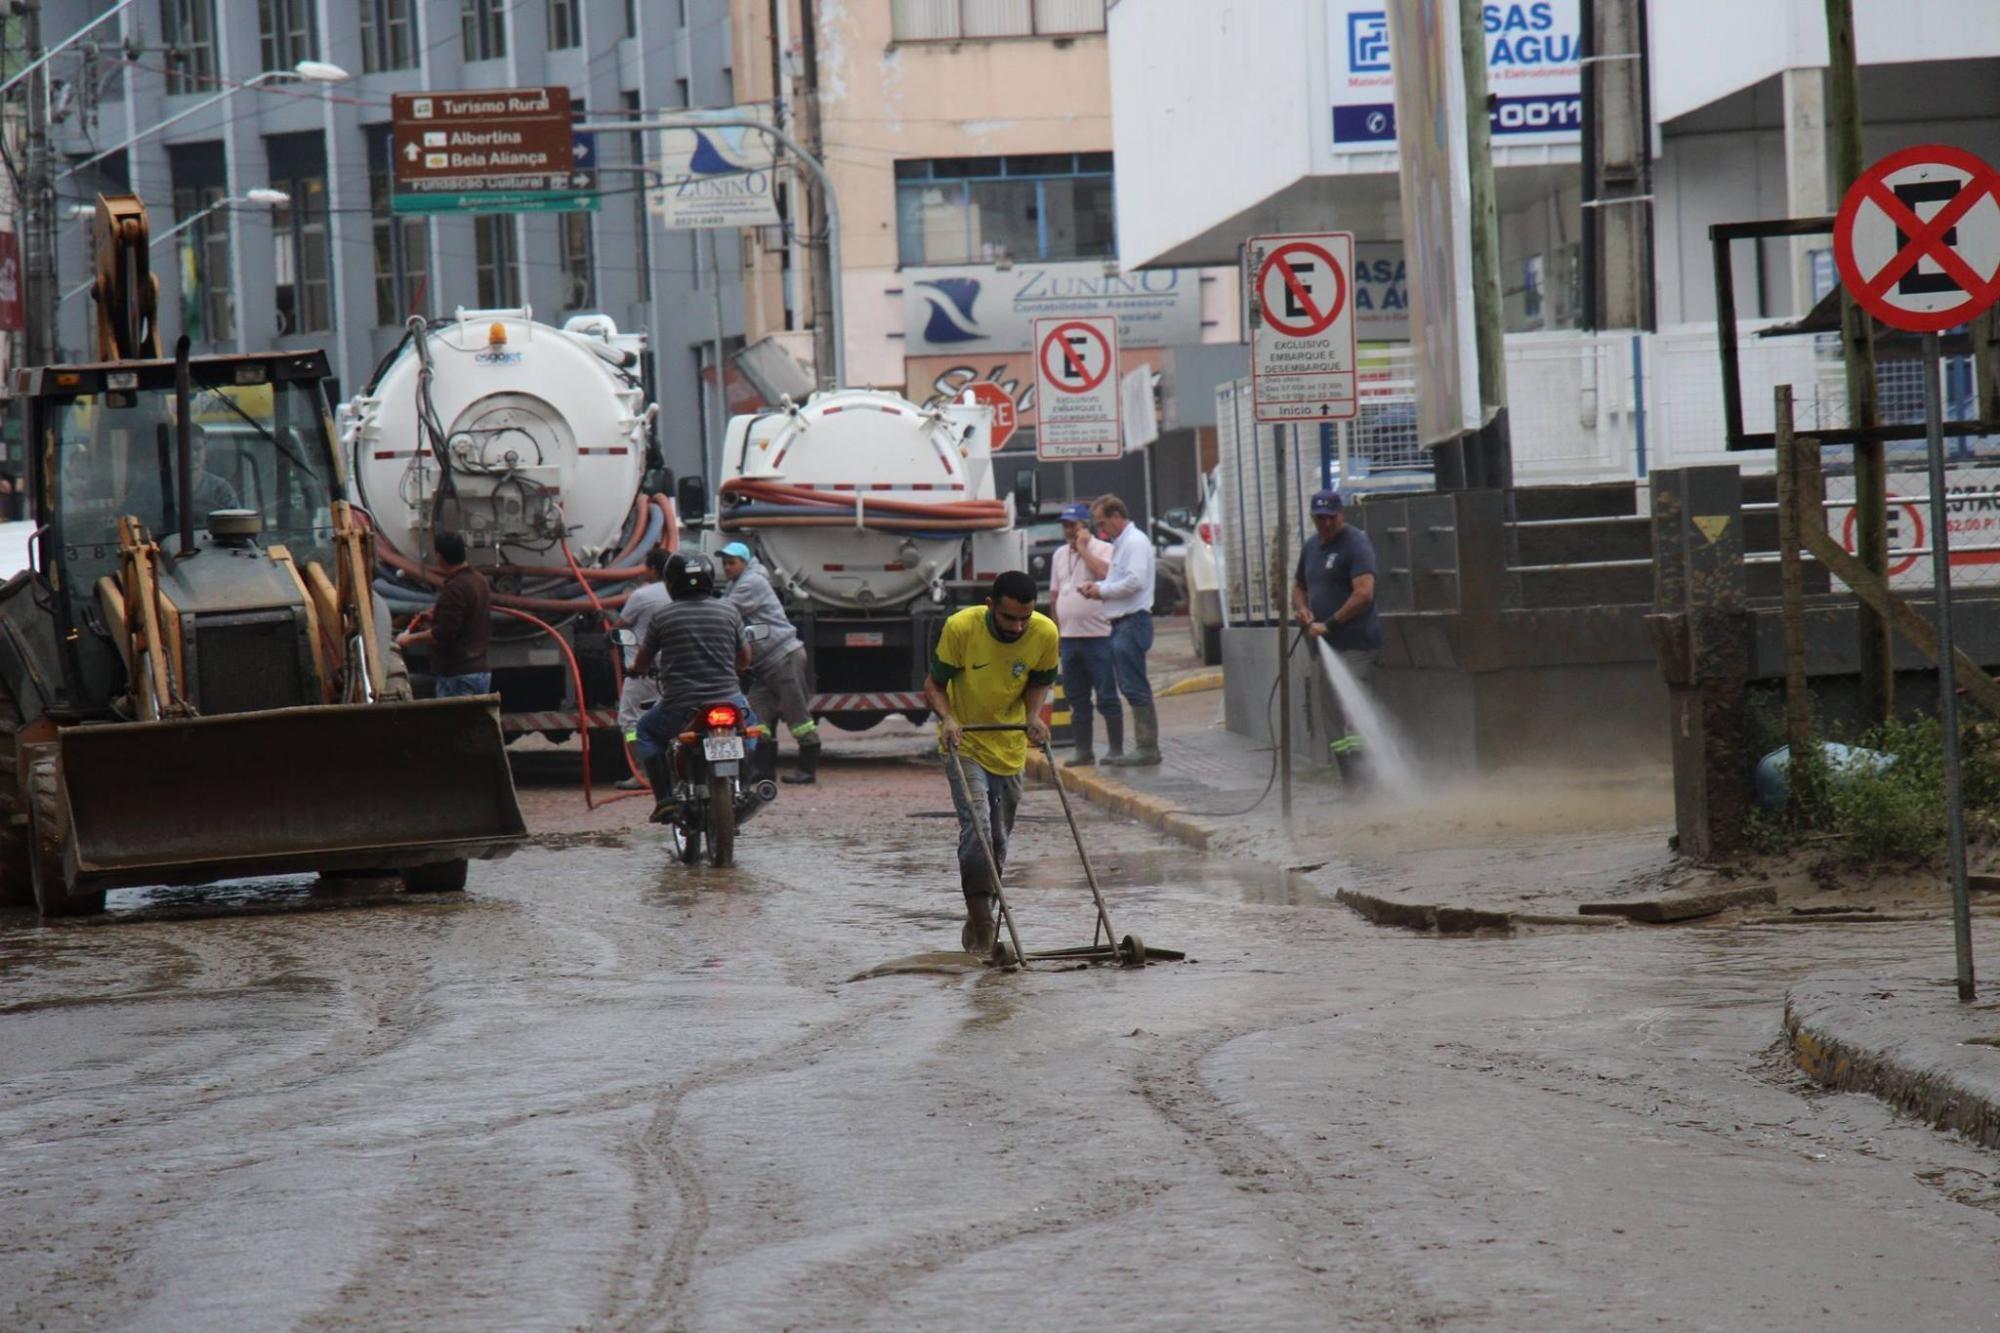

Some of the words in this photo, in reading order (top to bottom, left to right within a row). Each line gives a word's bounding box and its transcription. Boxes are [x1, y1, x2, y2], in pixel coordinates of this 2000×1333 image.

[443, 100, 505, 114] Turismo
[509, 97, 549, 112] Rural
[451, 131, 522, 145] Albertina
[452, 153, 486, 167] Bela
[490, 151, 547, 166] Aliança
[1015, 269, 1179, 297] ZUNINO
[1274, 340, 1330, 350] EXCLUSIVO
[1270, 351, 1326, 362] EMBARQUE
[1329, 350, 1336, 360] E
[1265, 362, 1341, 373] DESEMBARQUE
